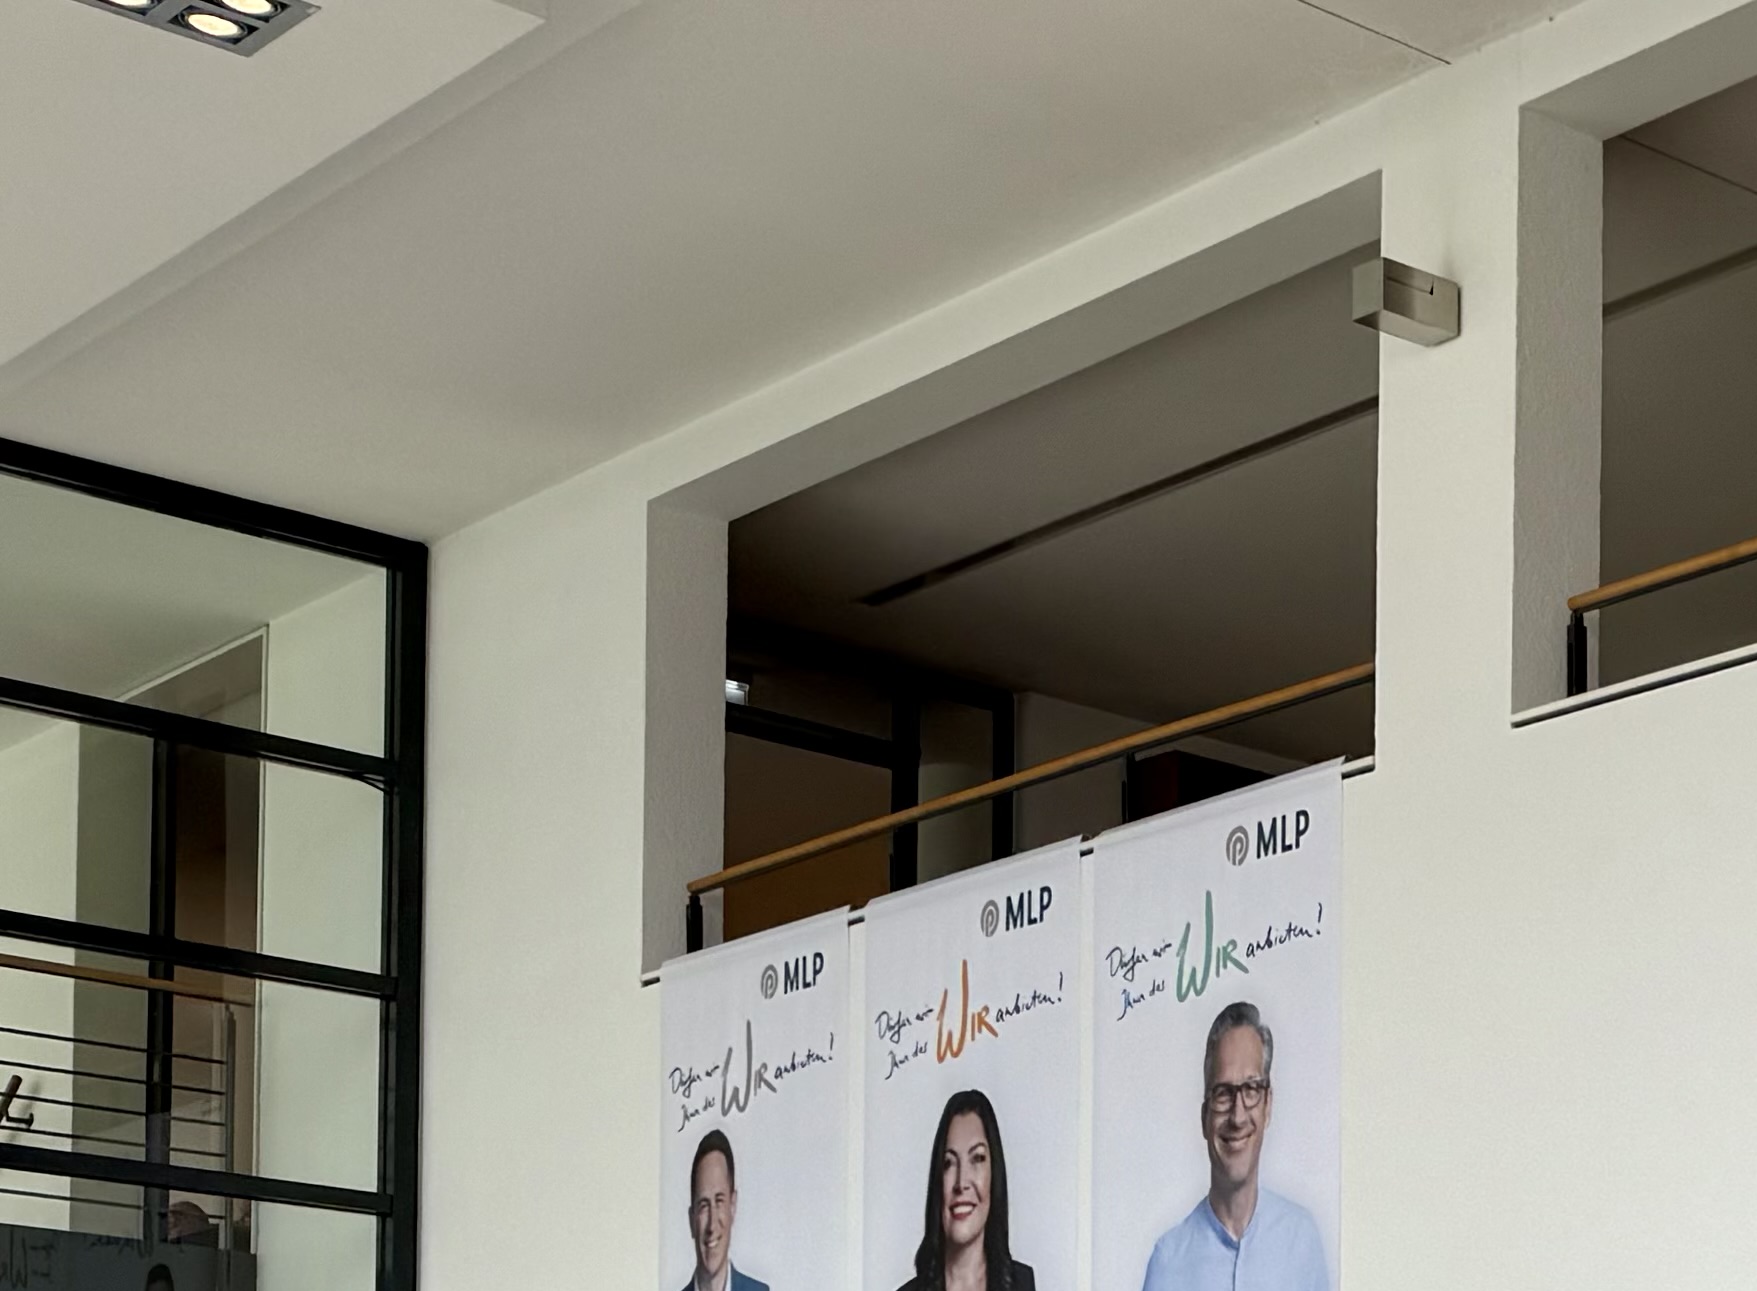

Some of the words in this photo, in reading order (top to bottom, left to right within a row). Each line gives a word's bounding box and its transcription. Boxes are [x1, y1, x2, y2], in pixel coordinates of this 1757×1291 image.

[1256, 809, 1310, 859] MLP
[1005, 886, 1052, 932] MLP
[783, 952, 824, 995] MLP
